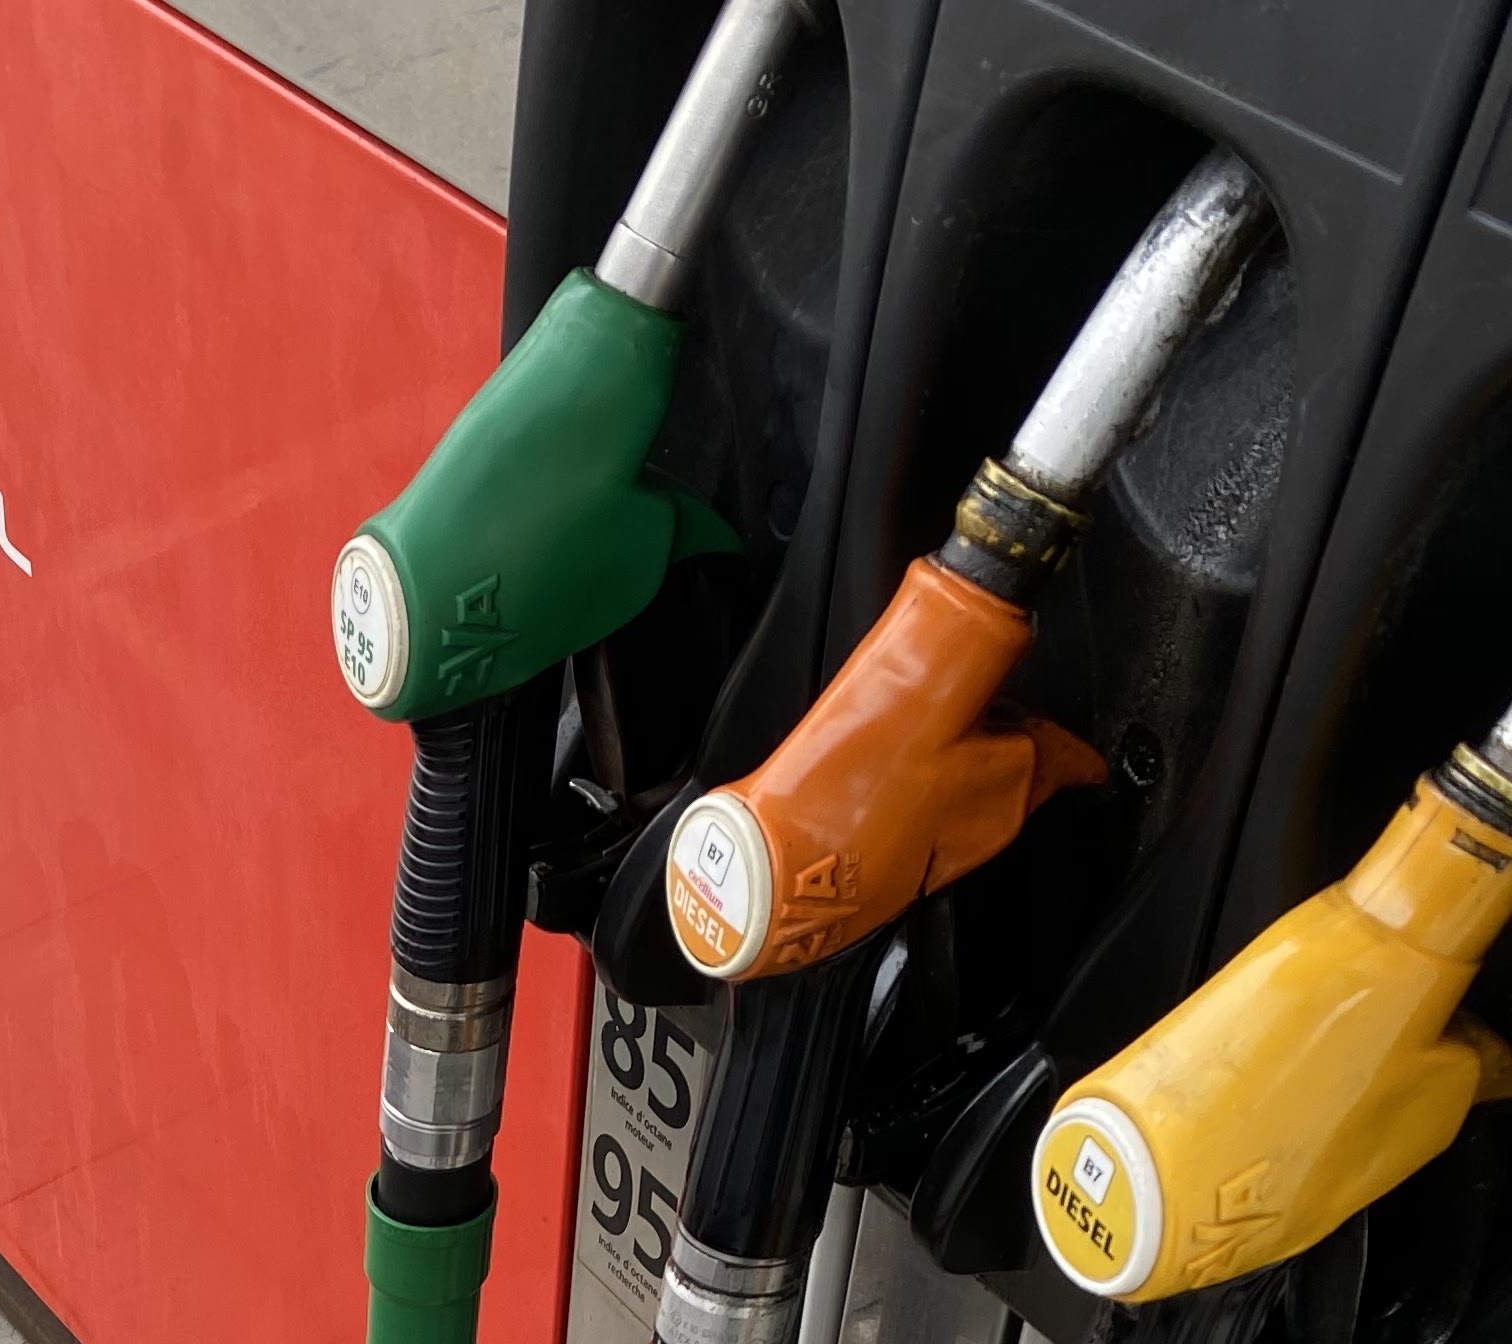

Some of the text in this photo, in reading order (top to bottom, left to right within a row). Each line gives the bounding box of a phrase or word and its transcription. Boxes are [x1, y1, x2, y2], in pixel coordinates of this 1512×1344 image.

[353, 578, 369, 605] E10
[341, 610, 374, 665] SP 95
[344, 645, 366, 686] E10
[707, 843, 724, 866] B7
[688, 868, 724, 912] excellium
[674, 880, 727, 957] DIESEL
[601, 986, 695, 1129] 85
[611, 1085, 673, 1150] Indice d'octane
[625, 1120, 655, 1152] moteur
[1083, 1157, 1103, 1183] B7
[591, 1133, 678, 1279] 95
[1046, 1166, 1115, 1261] DIESEL
[598, 1233, 621, 1262] Indice
[607, 1261, 645, 1303] recherche
